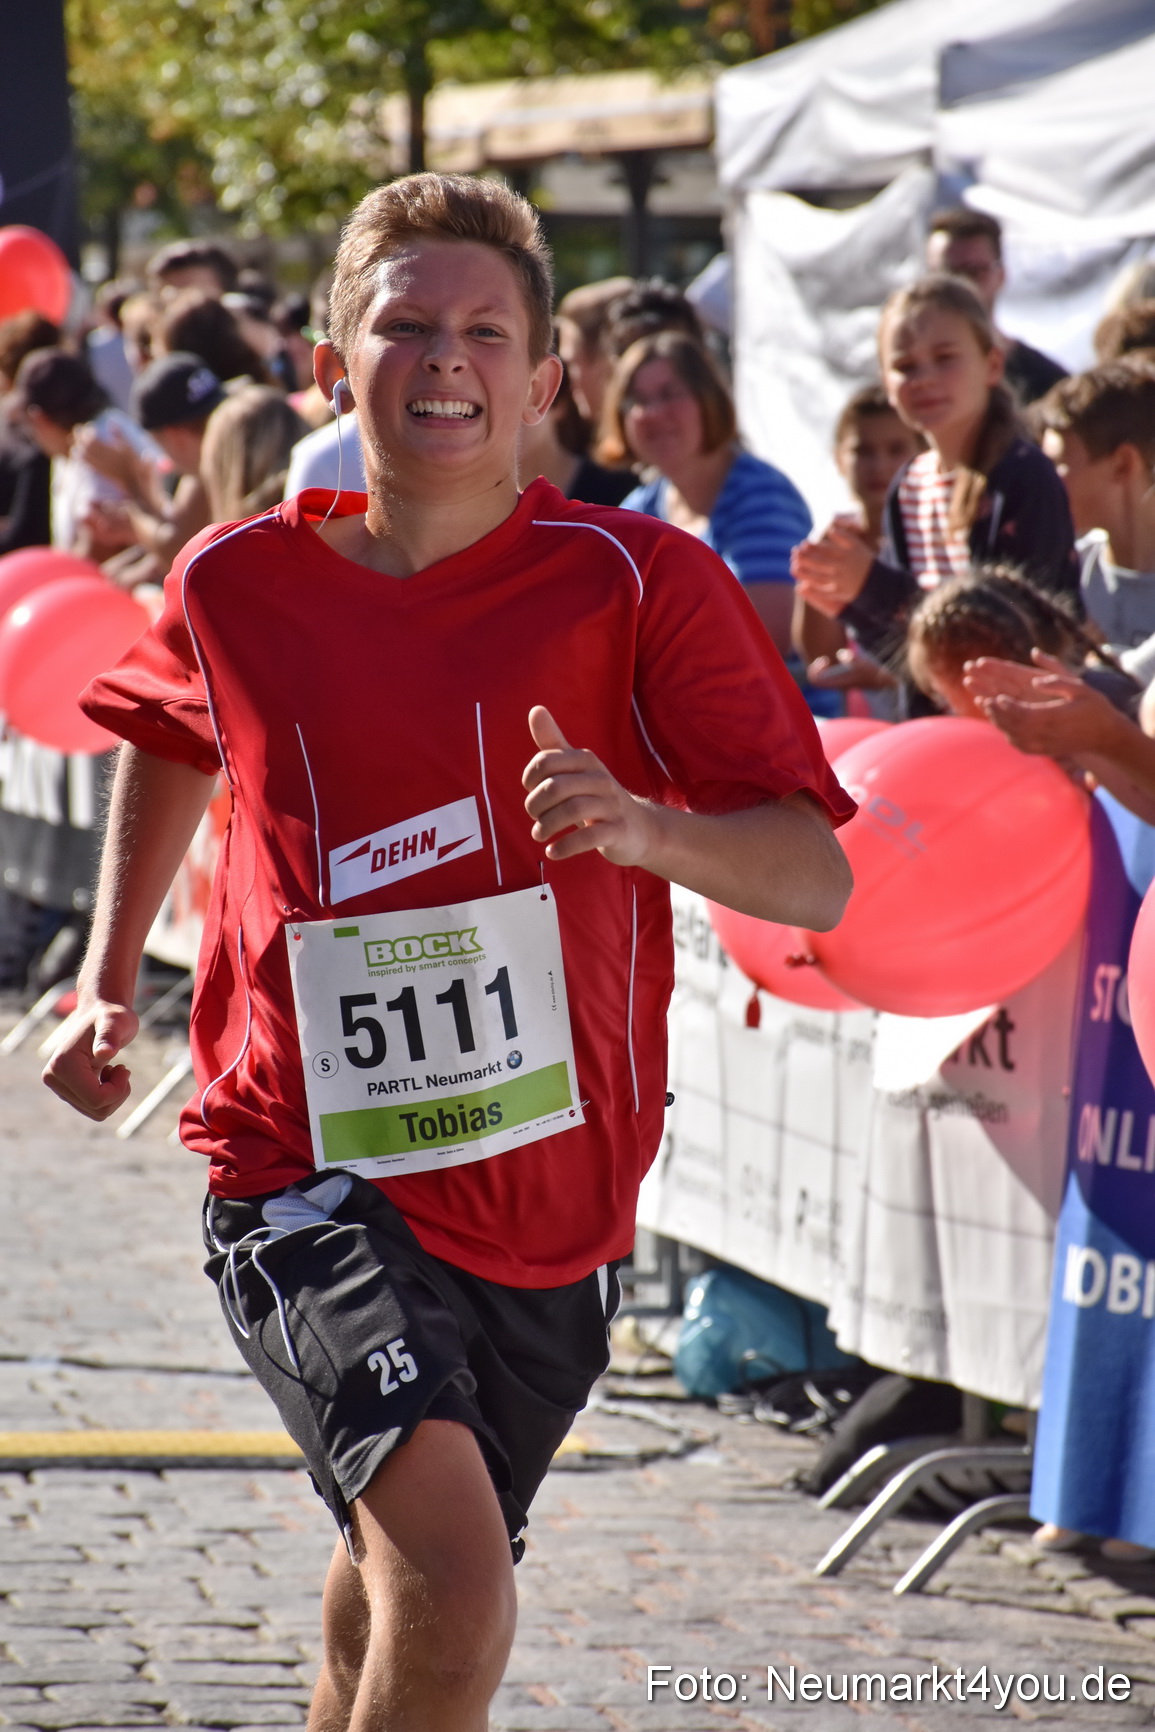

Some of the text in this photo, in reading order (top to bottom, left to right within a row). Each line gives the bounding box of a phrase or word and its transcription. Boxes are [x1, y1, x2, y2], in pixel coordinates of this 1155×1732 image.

[370, 826, 437, 874] DEHN
[363, 926, 484, 968] BOCK
[367, 953, 487, 978] inspired by smart concepts
[339, 965, 519, 1070] 5111
[319, 1057, 331, 1073] S
[366, 1060, 503, 1097] PARTL Neumarkt
[398, 1101, 504, 1143] Tobias
[367, 1337, 419, 1397] 25
